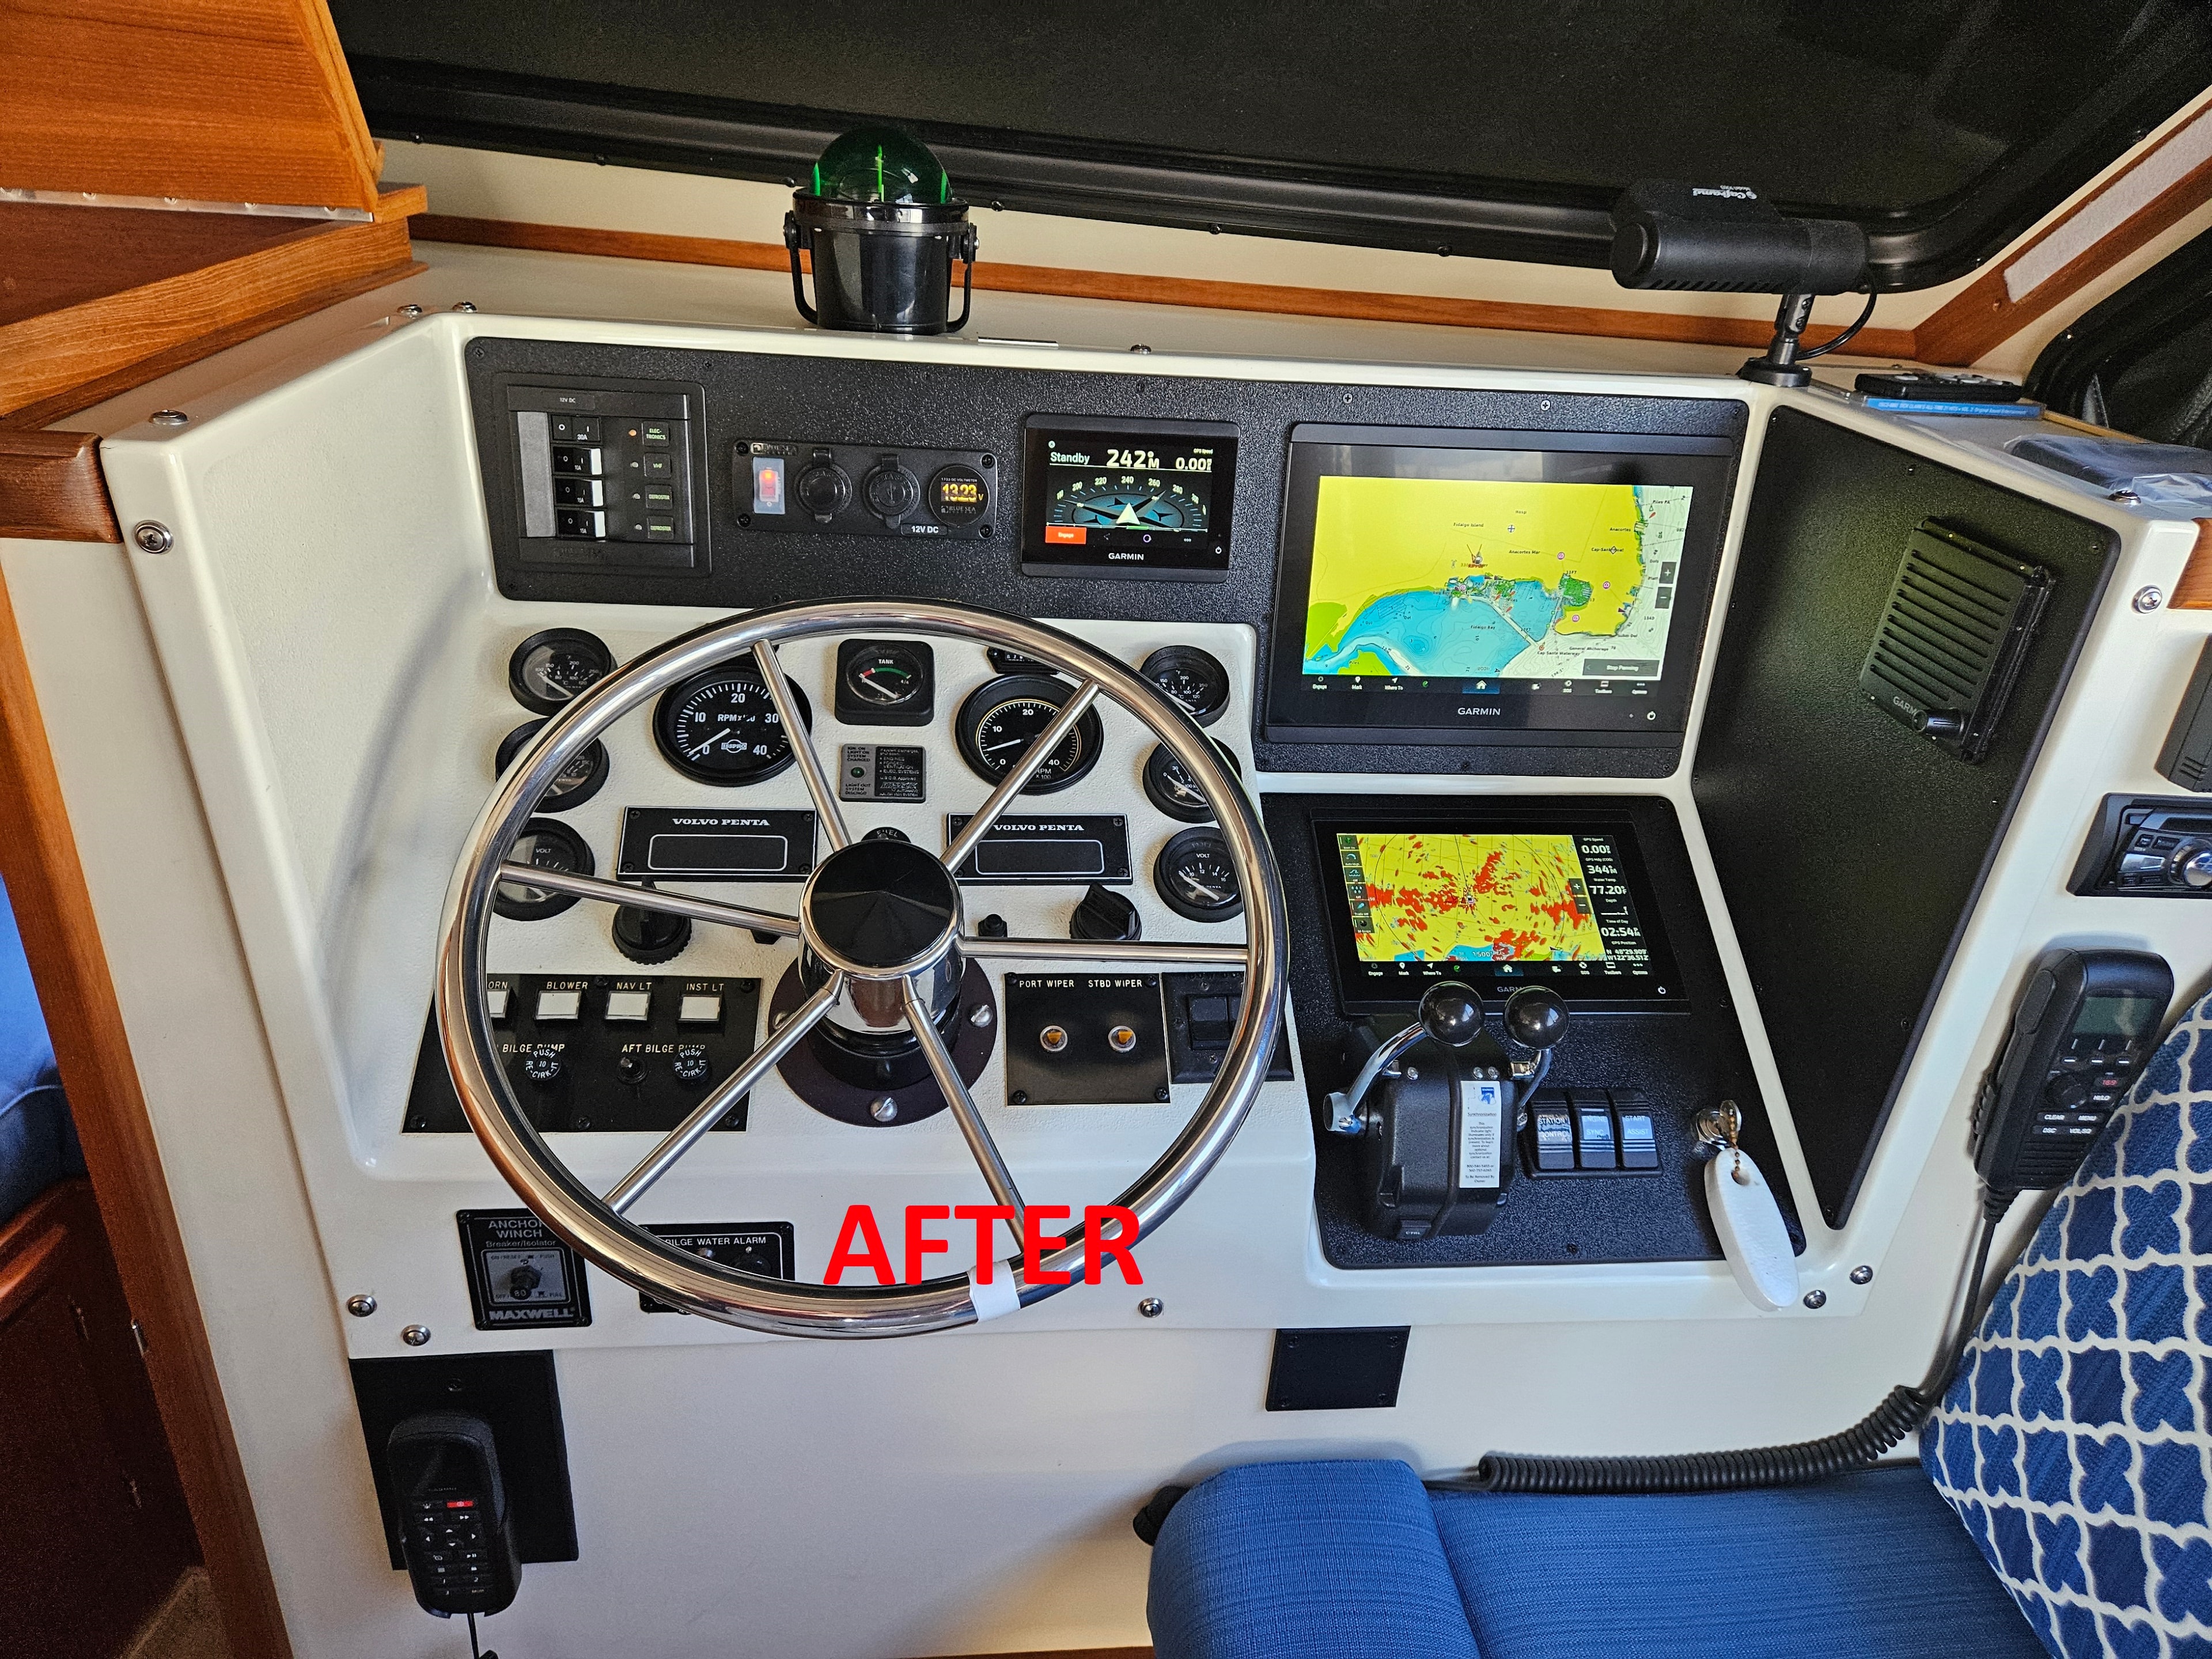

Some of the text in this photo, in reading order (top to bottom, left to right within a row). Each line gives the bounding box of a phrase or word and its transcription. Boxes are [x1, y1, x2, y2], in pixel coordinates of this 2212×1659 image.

[1050, 452, 1090, 465] Standby
[1094, 476, 1161, 487] 220 260
[1121, 476, 1134, 484] 240
[1108, 552, 1145, 560] GARMIN
[731, 693, 745, 703] 20
[1457, 707, 1501, 715] GARMIN
[695, 712, 706, 723] 10
[764, 713, 779, 724] 30
[702, 745, 710, 755] 0
[753, 745, 767, 756] 40
[546, 982, 589, 990] BLOWER
[502, 1044, 533, 1053] BILGE
[622, 1044, 675, 1053] AFT BILGE
[680, 1048, 702, 1059] PUSH
[533, 1049, 556, 1059] PUSH
[495, 1229, 543, 1238] WINCH
[665, 1238, 693, 1246] BILGE
[733, 1236, 767, 1245] ALARM
[488, 1308, 573, 1321] MAXWELL
